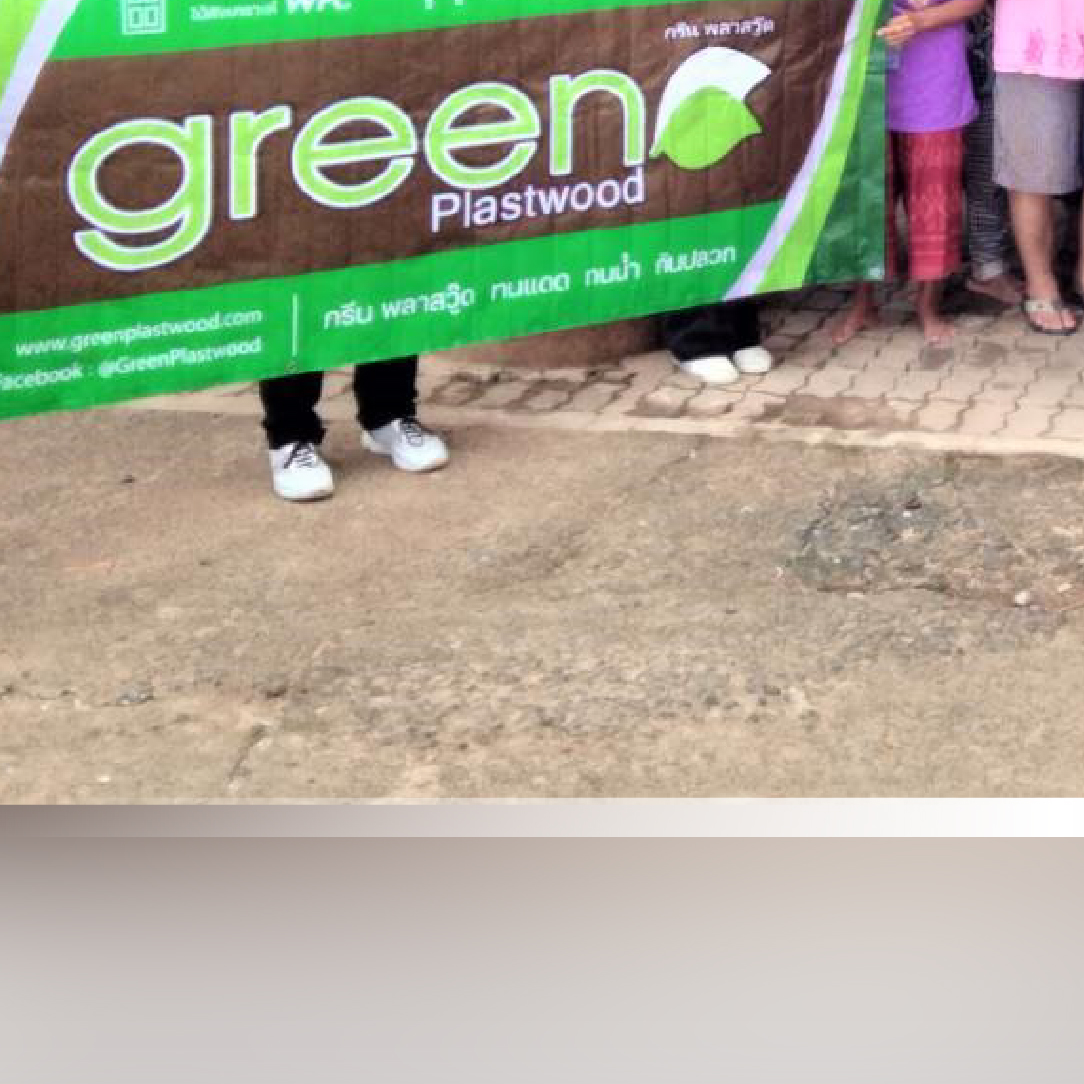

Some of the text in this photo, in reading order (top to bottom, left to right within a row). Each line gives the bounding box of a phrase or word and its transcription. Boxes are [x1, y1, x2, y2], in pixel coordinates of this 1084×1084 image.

[68, 69, 646, 271] green
[431, 166, 645, 233] Plastwood
[323, 300, 374, 329] กรีน
[491, 272, 570, 302] ทนแดด
[655, 246, 737, 274] กันปลวก
[15, 310, 263, 356] www.greenplastwood.com
[98, 336, 262, 378] @GreenPlastwood
